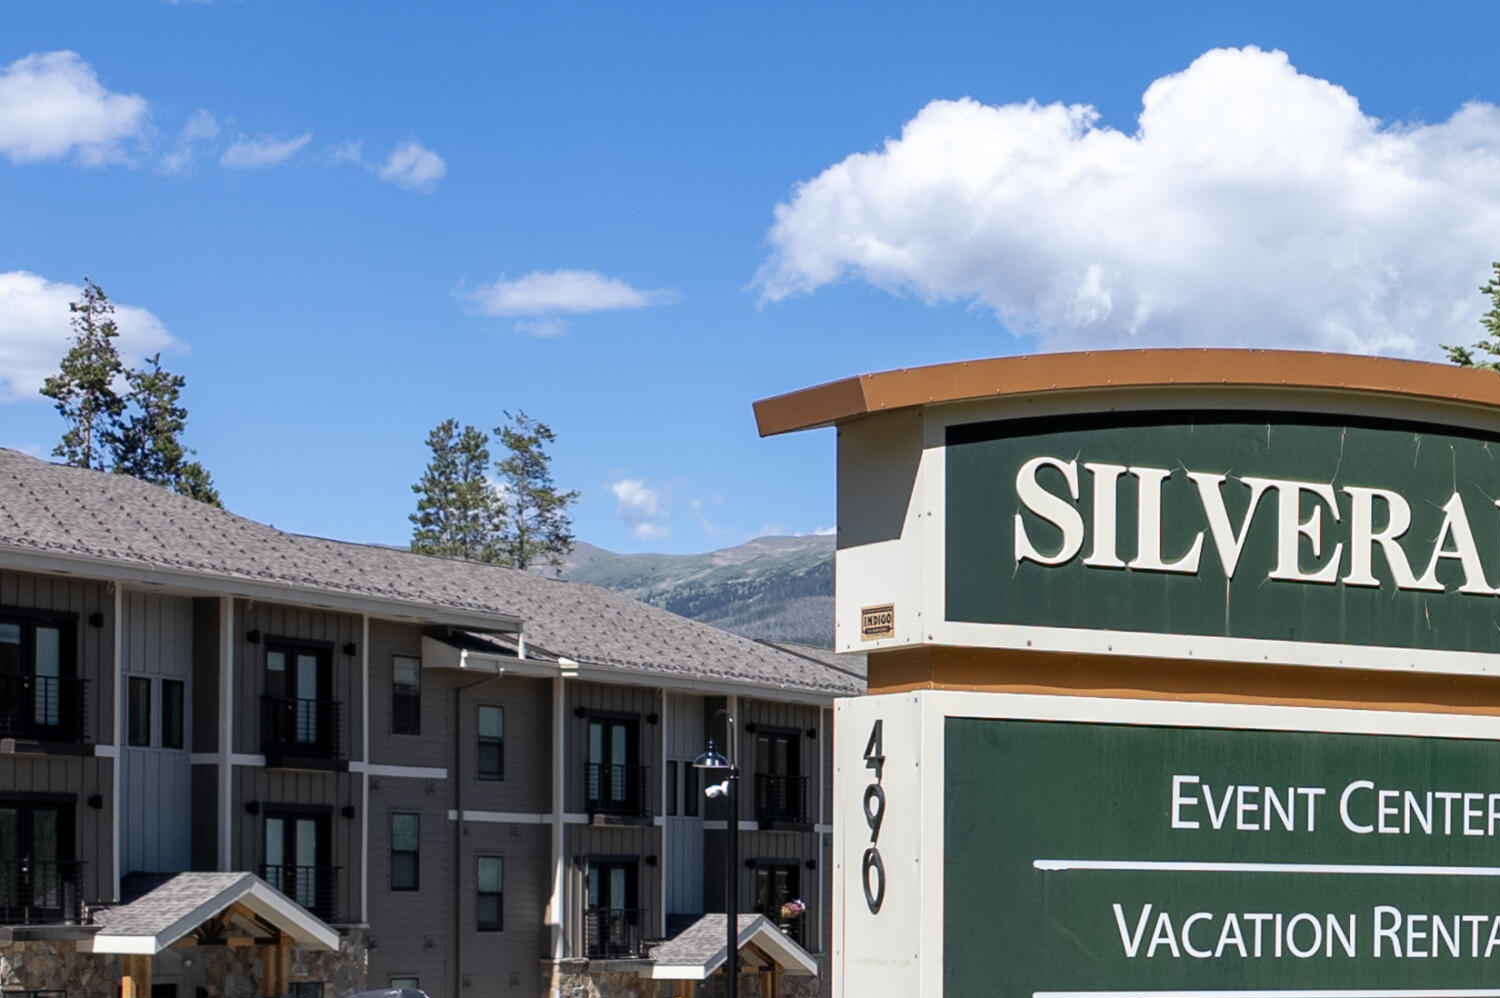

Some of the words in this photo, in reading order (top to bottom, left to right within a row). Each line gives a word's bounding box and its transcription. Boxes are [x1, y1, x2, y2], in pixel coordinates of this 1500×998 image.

[863, 719, 886, 915] 490
[1171, 774, 1326, 832] EVENT
[1112, 903, 1356, 958] VACATION
